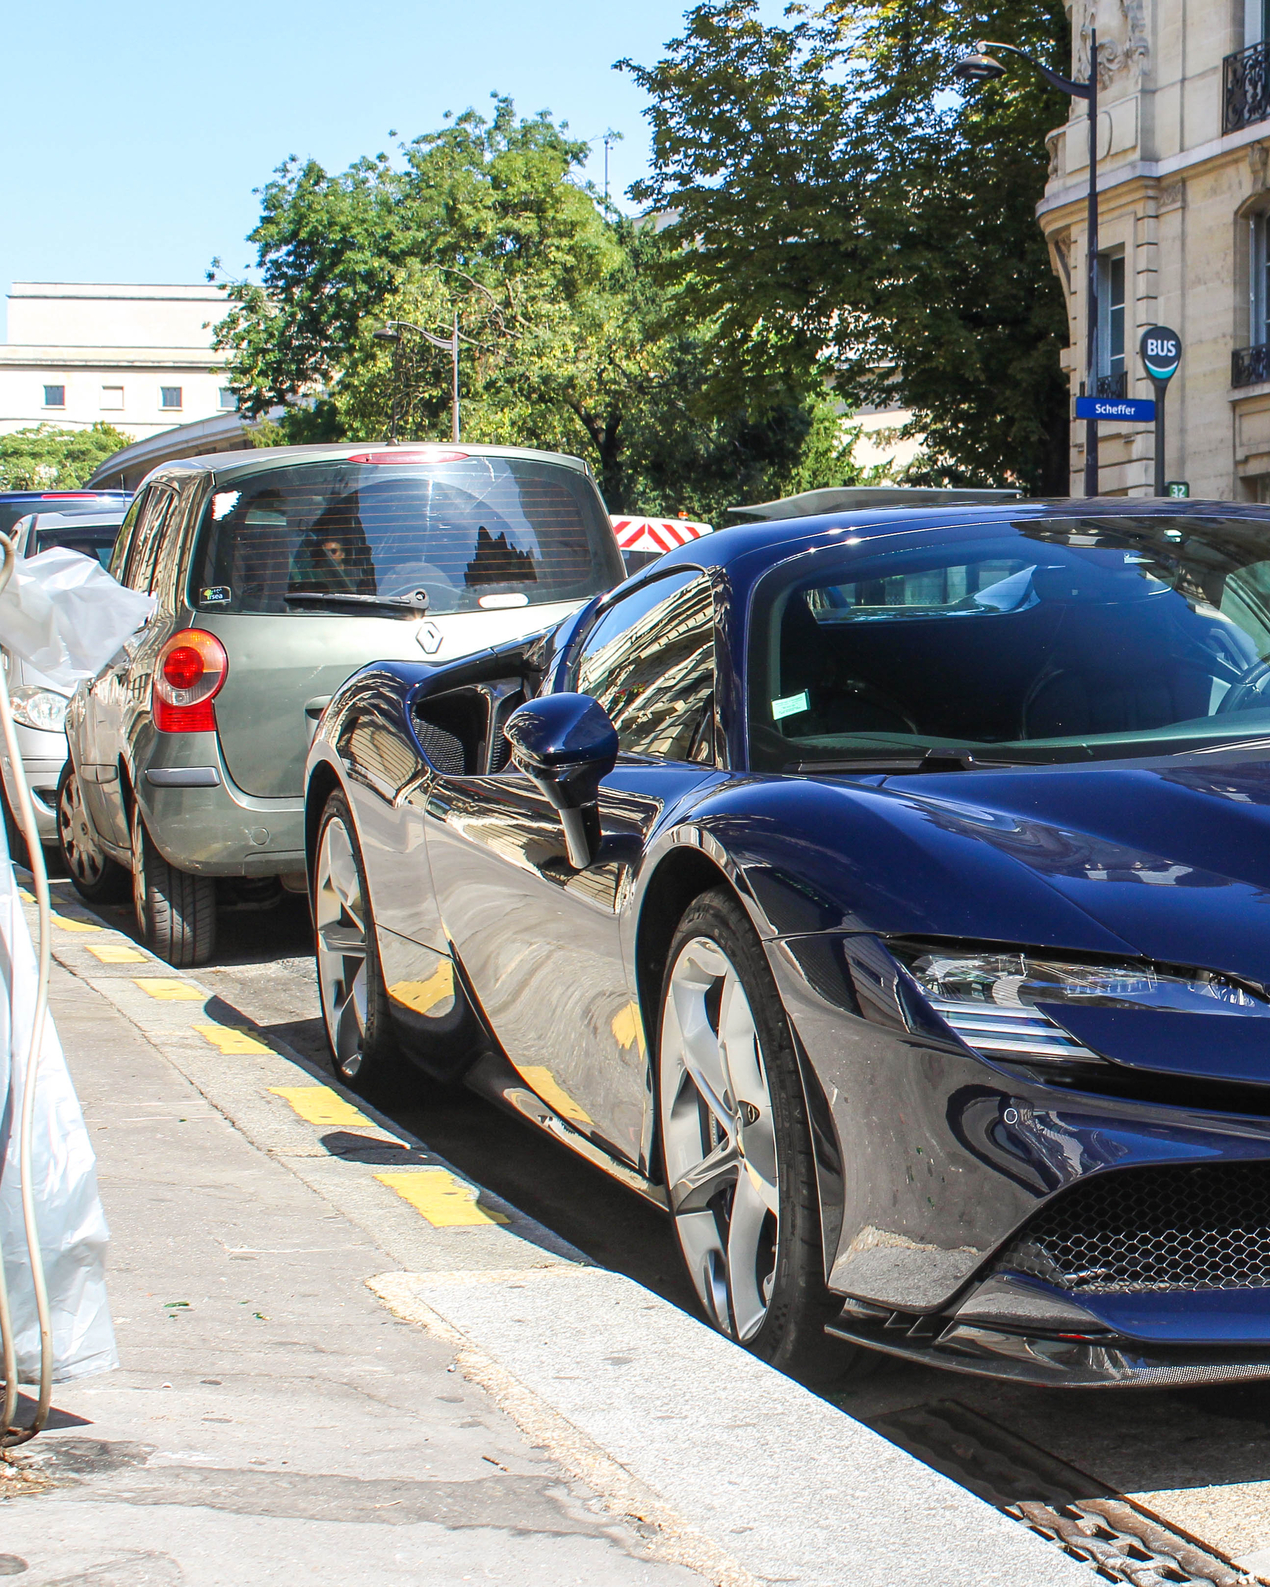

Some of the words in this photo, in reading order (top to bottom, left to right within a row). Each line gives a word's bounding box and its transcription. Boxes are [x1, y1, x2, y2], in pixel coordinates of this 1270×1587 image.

[1147, 338, 1176, 357] BUS
[1095, 403, 1136, 415] Scheffer
[1171, 484, 1186, 498] 32
